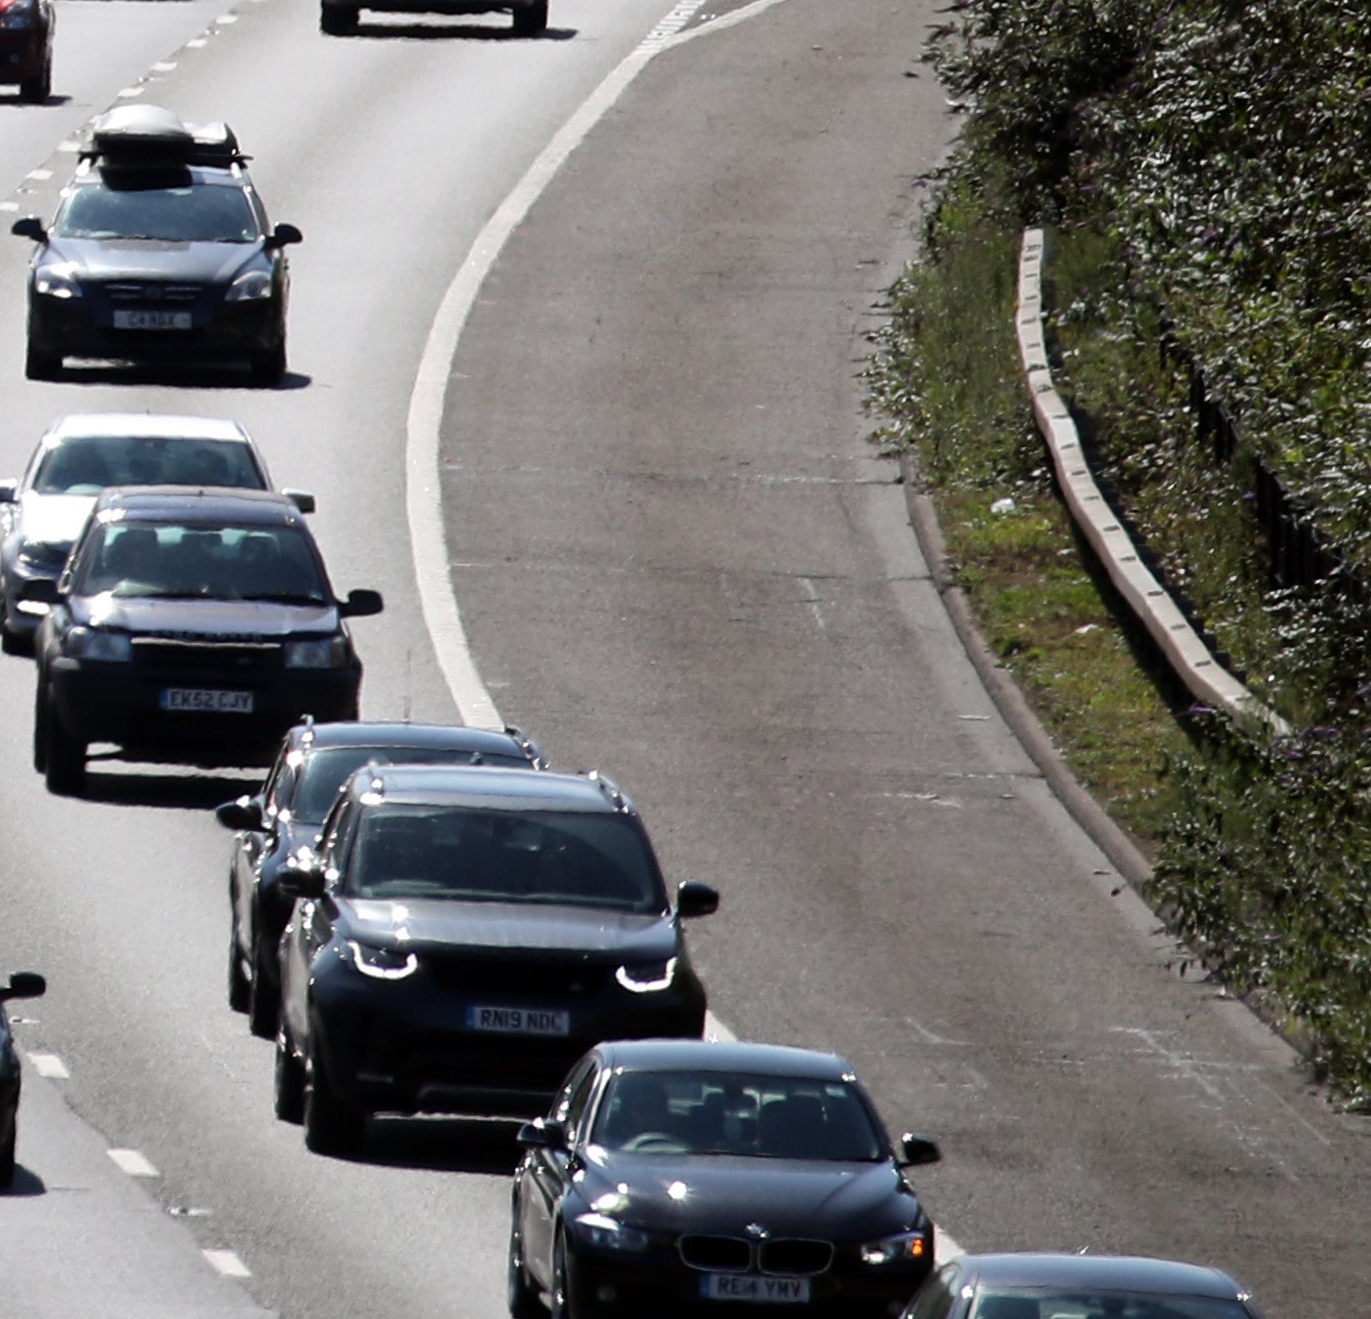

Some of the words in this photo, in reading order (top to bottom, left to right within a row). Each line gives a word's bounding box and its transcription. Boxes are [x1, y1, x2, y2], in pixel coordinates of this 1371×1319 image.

[169, 690, 214, 711] EK52
[217, 691, 252, 712] CJY
[479, 1009, 522, 1031] RN19
[525, 1011, 564, 1033] NDC
[716, 1277, 758, 1296] RE14
[763, 1278, 803, 1299] YMV
